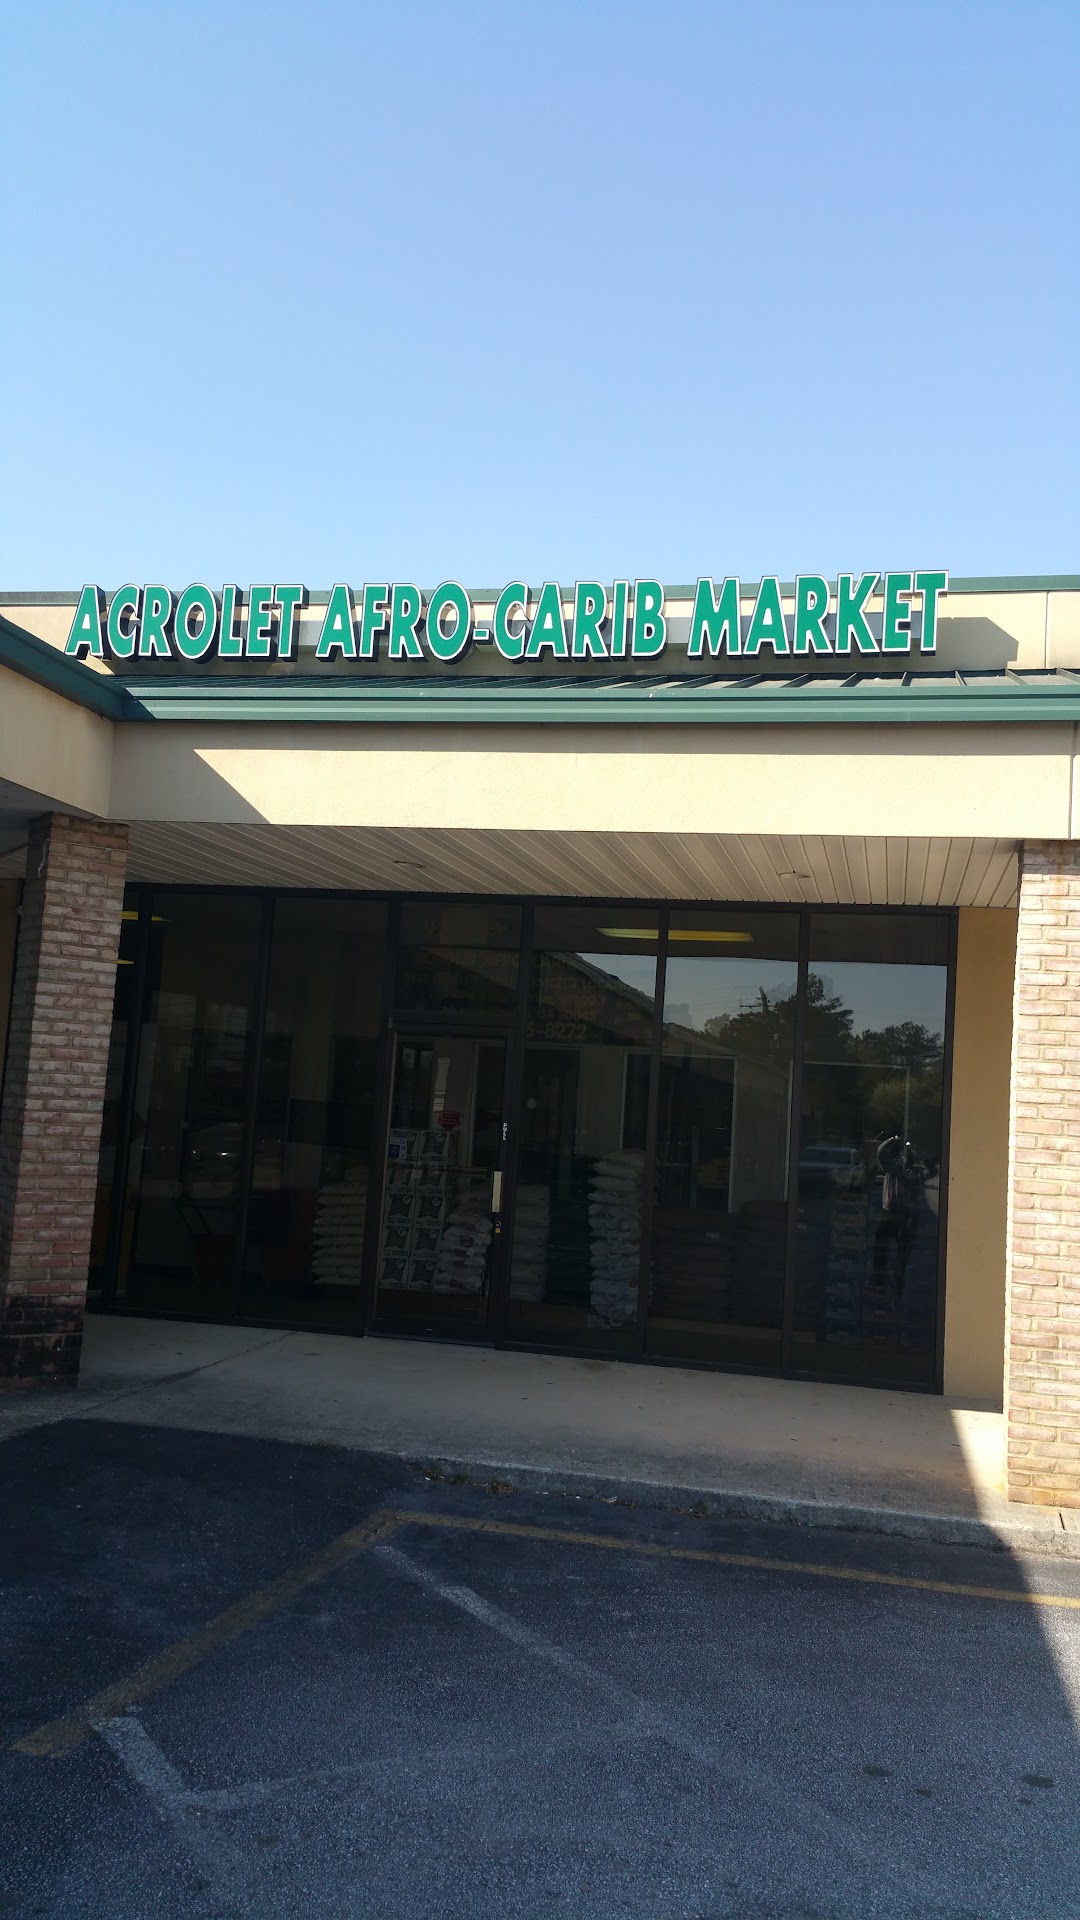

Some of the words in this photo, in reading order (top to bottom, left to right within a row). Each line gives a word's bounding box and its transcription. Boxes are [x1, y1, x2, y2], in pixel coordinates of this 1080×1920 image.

[65, 582, 307, 660] ACROLET
[316, 580, 668, 661] AFRO-CARIB
[687, 569, 950, 658] MARKET
